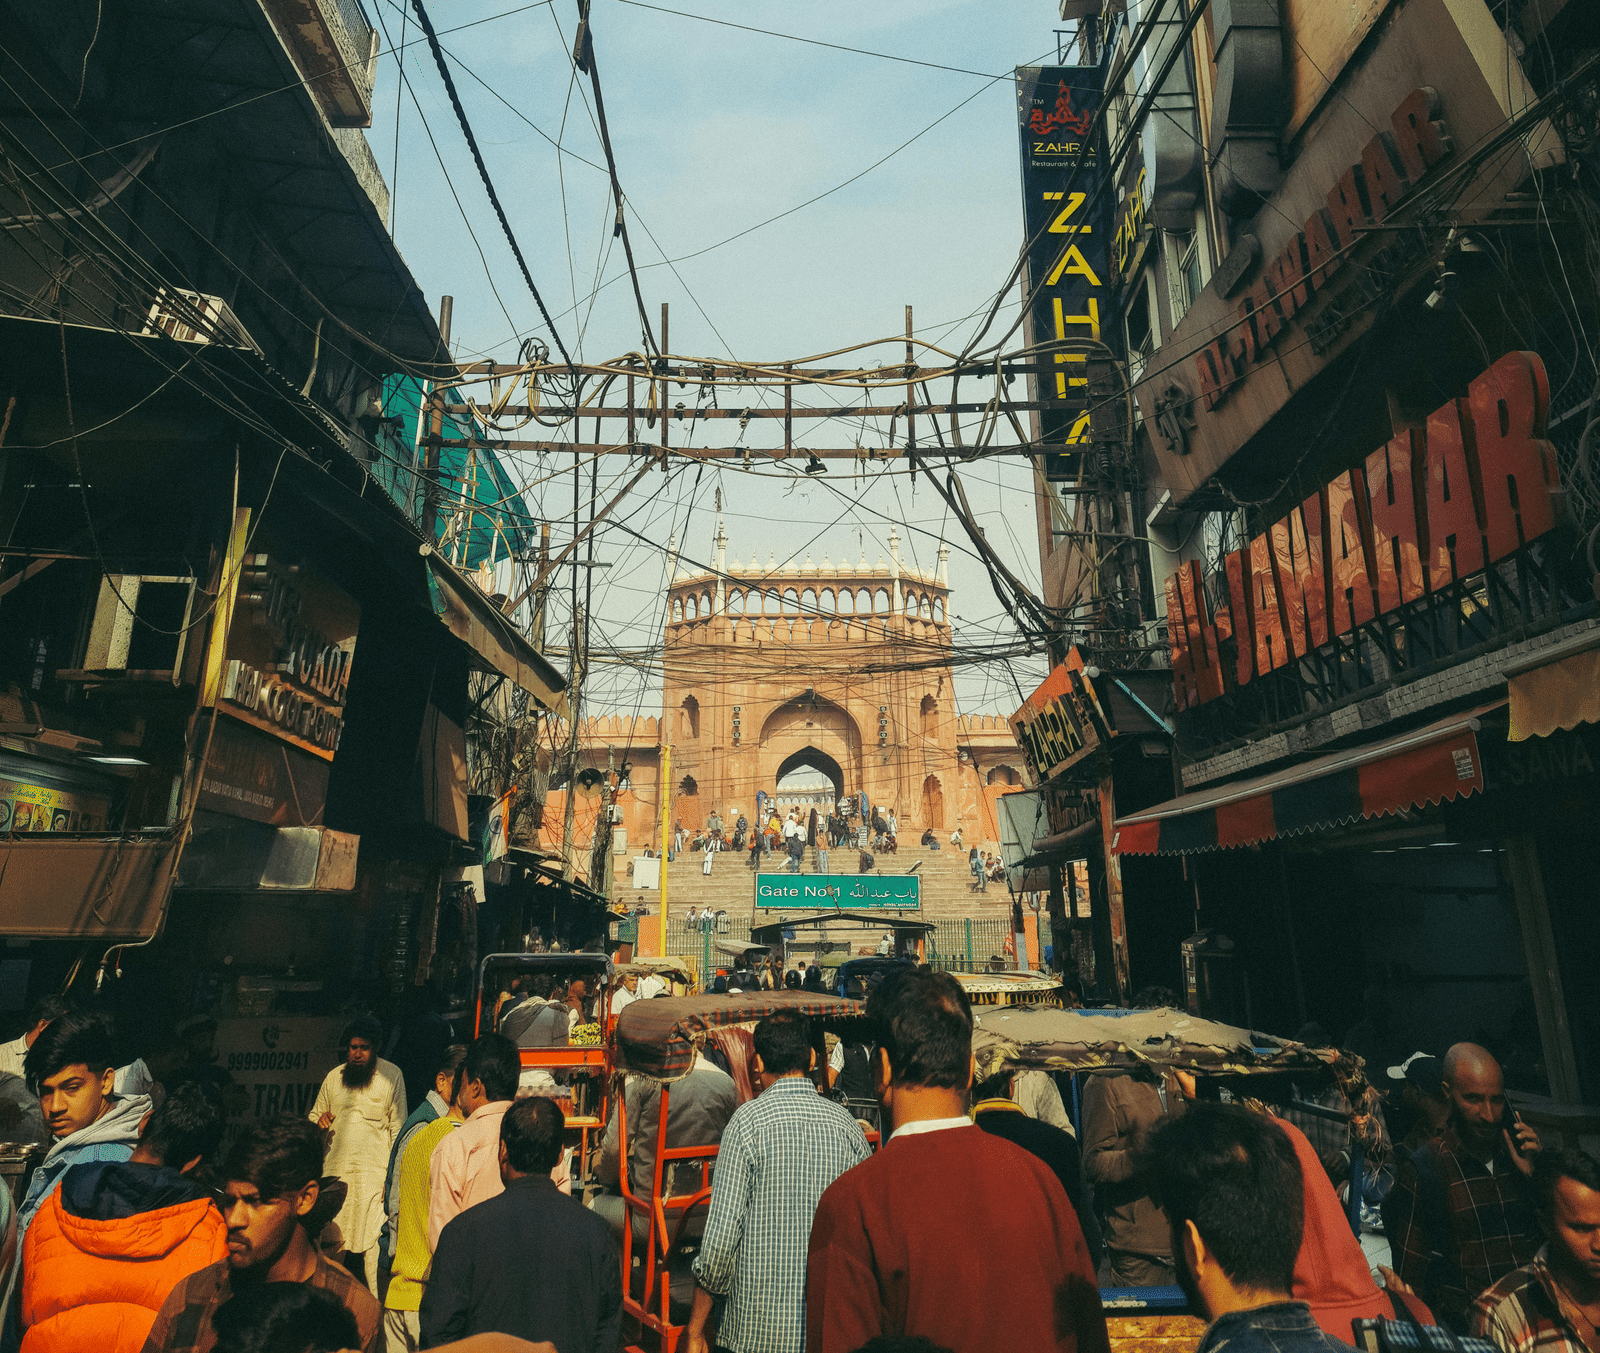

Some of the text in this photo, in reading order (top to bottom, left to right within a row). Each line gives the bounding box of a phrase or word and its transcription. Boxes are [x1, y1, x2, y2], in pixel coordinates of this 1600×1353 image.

[1031, 160, 1068, 168] Restaurant
[1195, 86, 1450, 412] AL-JAWAHAR
[1164, 351, 1560, 713] AL-JAWAHAR
[759, 885, 799, 897] Gate
[227, 1051, 309, 1071] 9999002941
